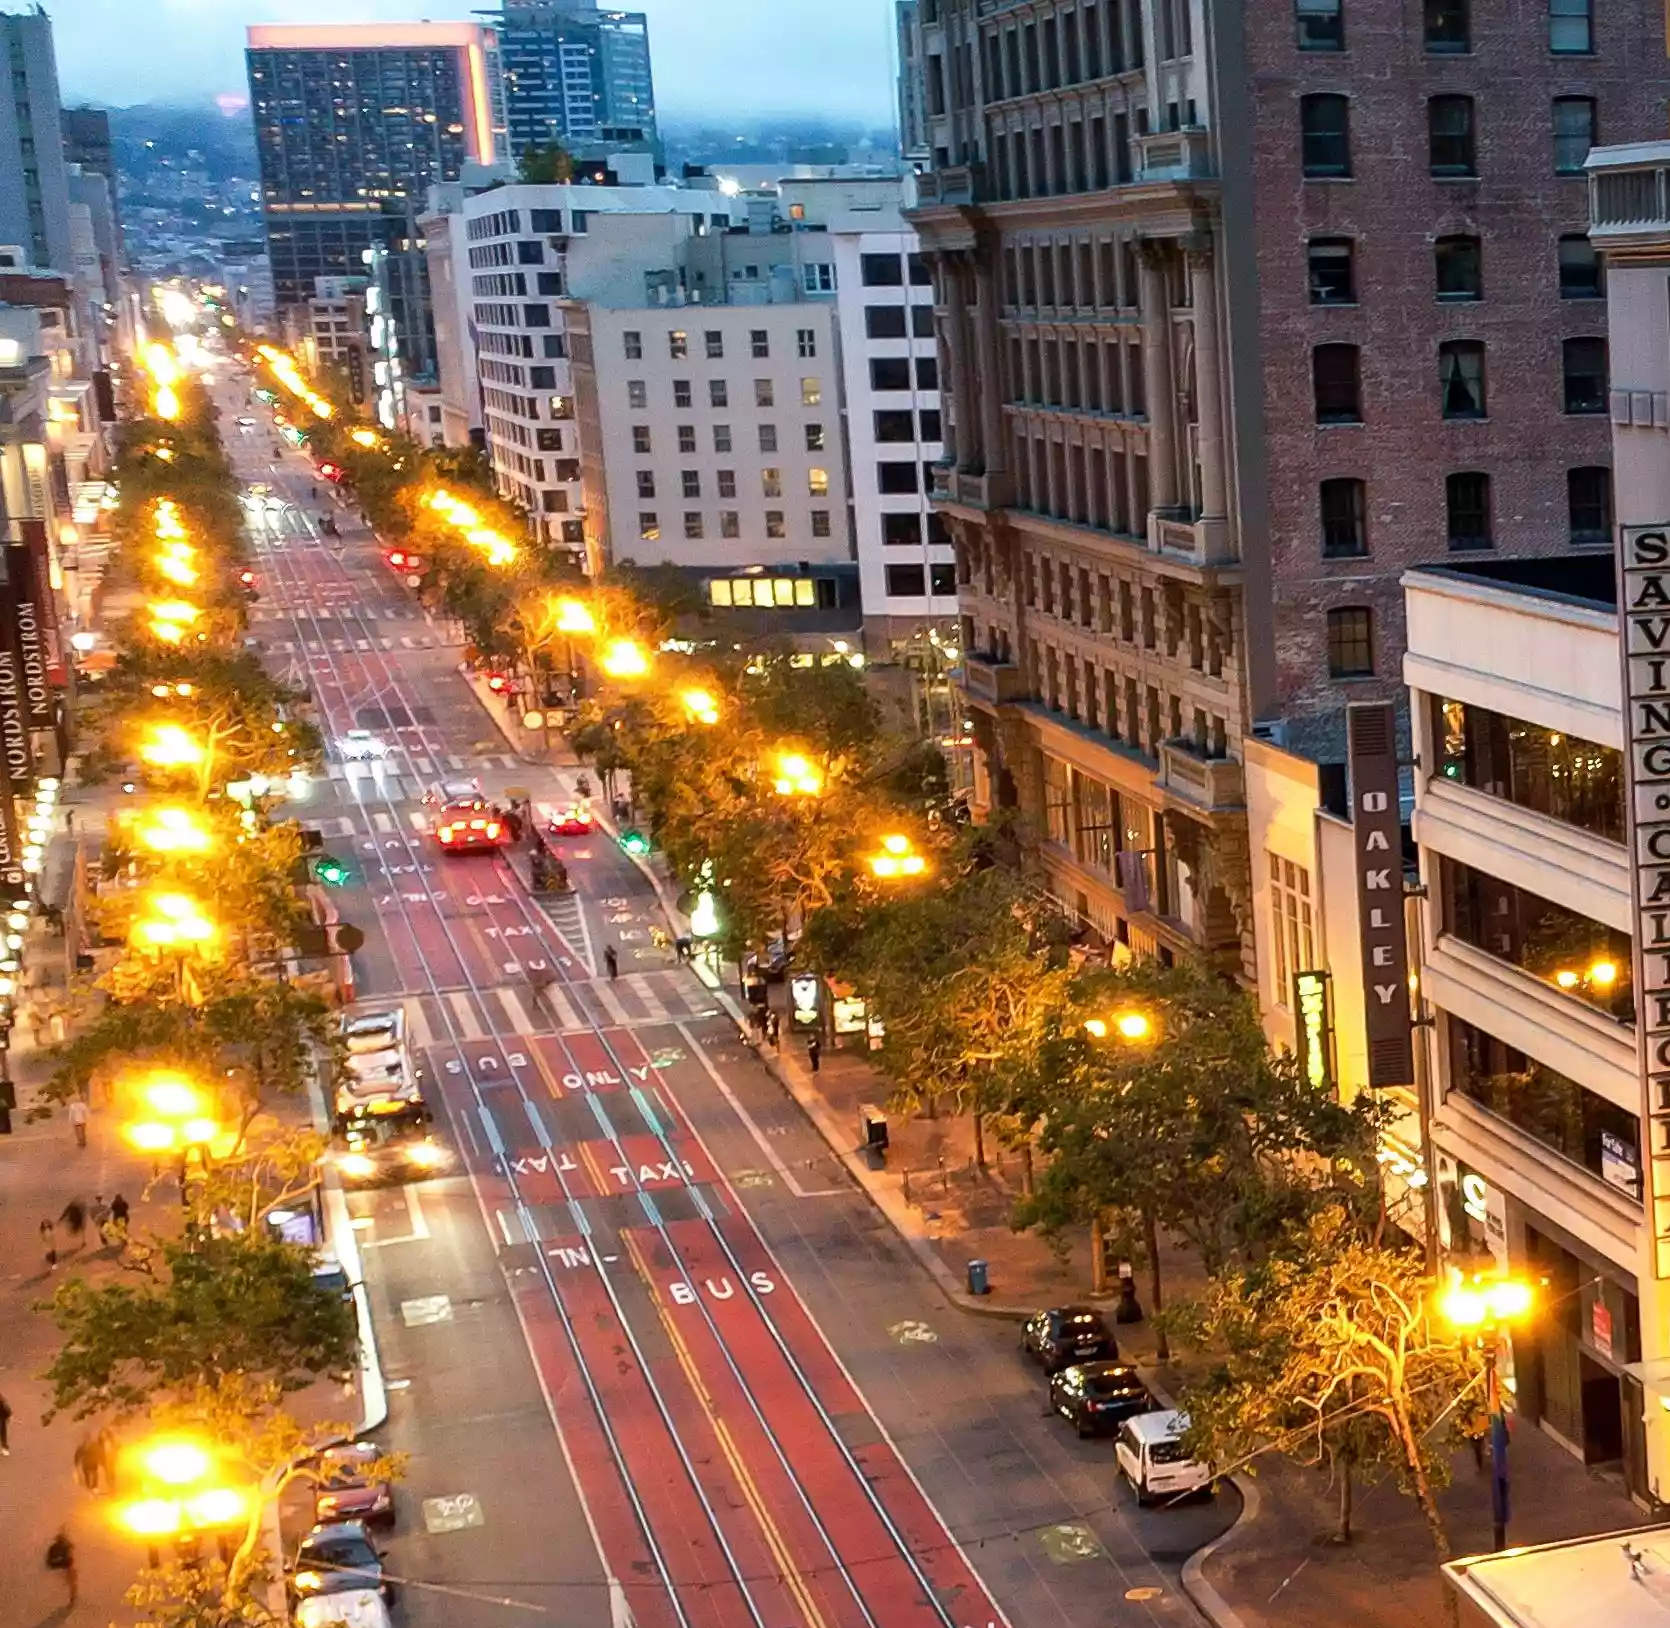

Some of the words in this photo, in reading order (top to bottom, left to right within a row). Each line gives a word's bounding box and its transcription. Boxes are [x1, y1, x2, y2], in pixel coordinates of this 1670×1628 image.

[17, 602, 48, 714] NORDSTROM
[1361, 791, 1398, 1005] OAKLEY
[562, 1063, 650, 1090] ONLY
[669, 1271, 775, 1306] BUS
